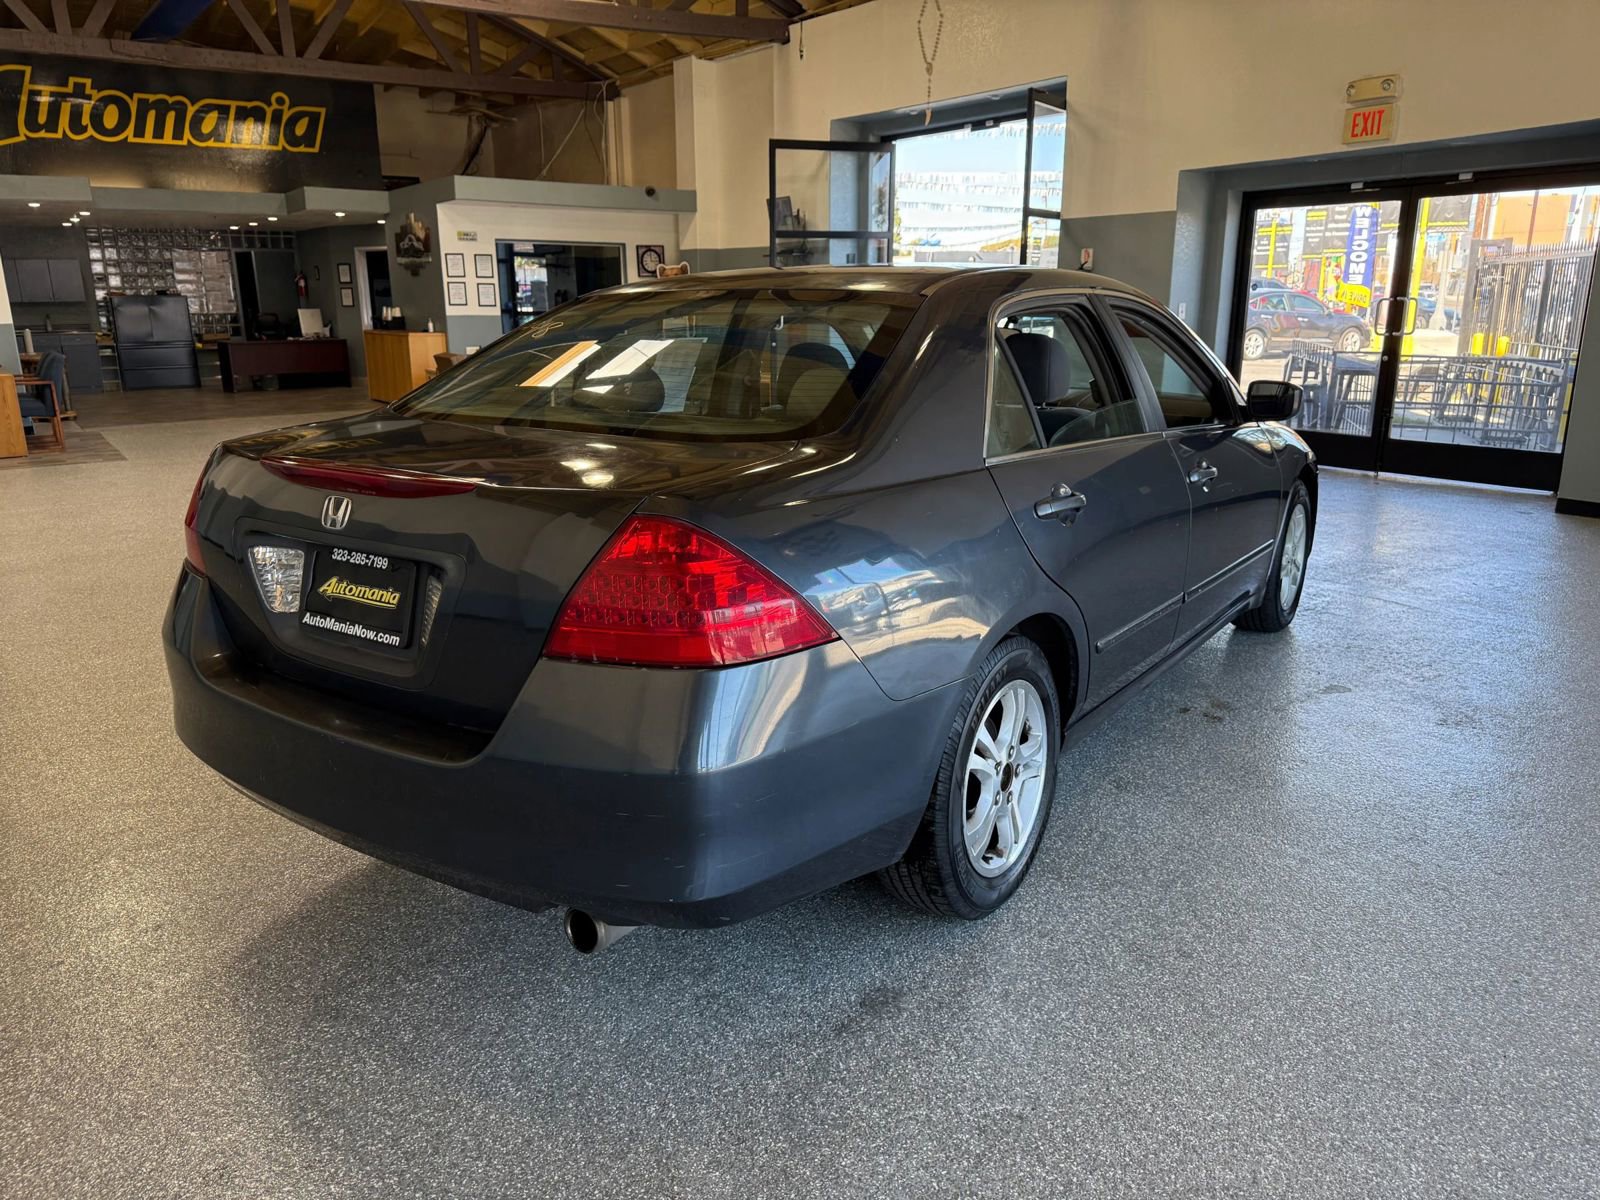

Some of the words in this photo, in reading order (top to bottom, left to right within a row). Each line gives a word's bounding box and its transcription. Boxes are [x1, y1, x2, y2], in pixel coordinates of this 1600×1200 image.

[1351, 108, 1386, 138] EXIT
[331, 548, 388, 569] 323-285-7199
[318, 576, 401, 605] Automania
[302, 612, 400, 646] AutoManiaNow.com
